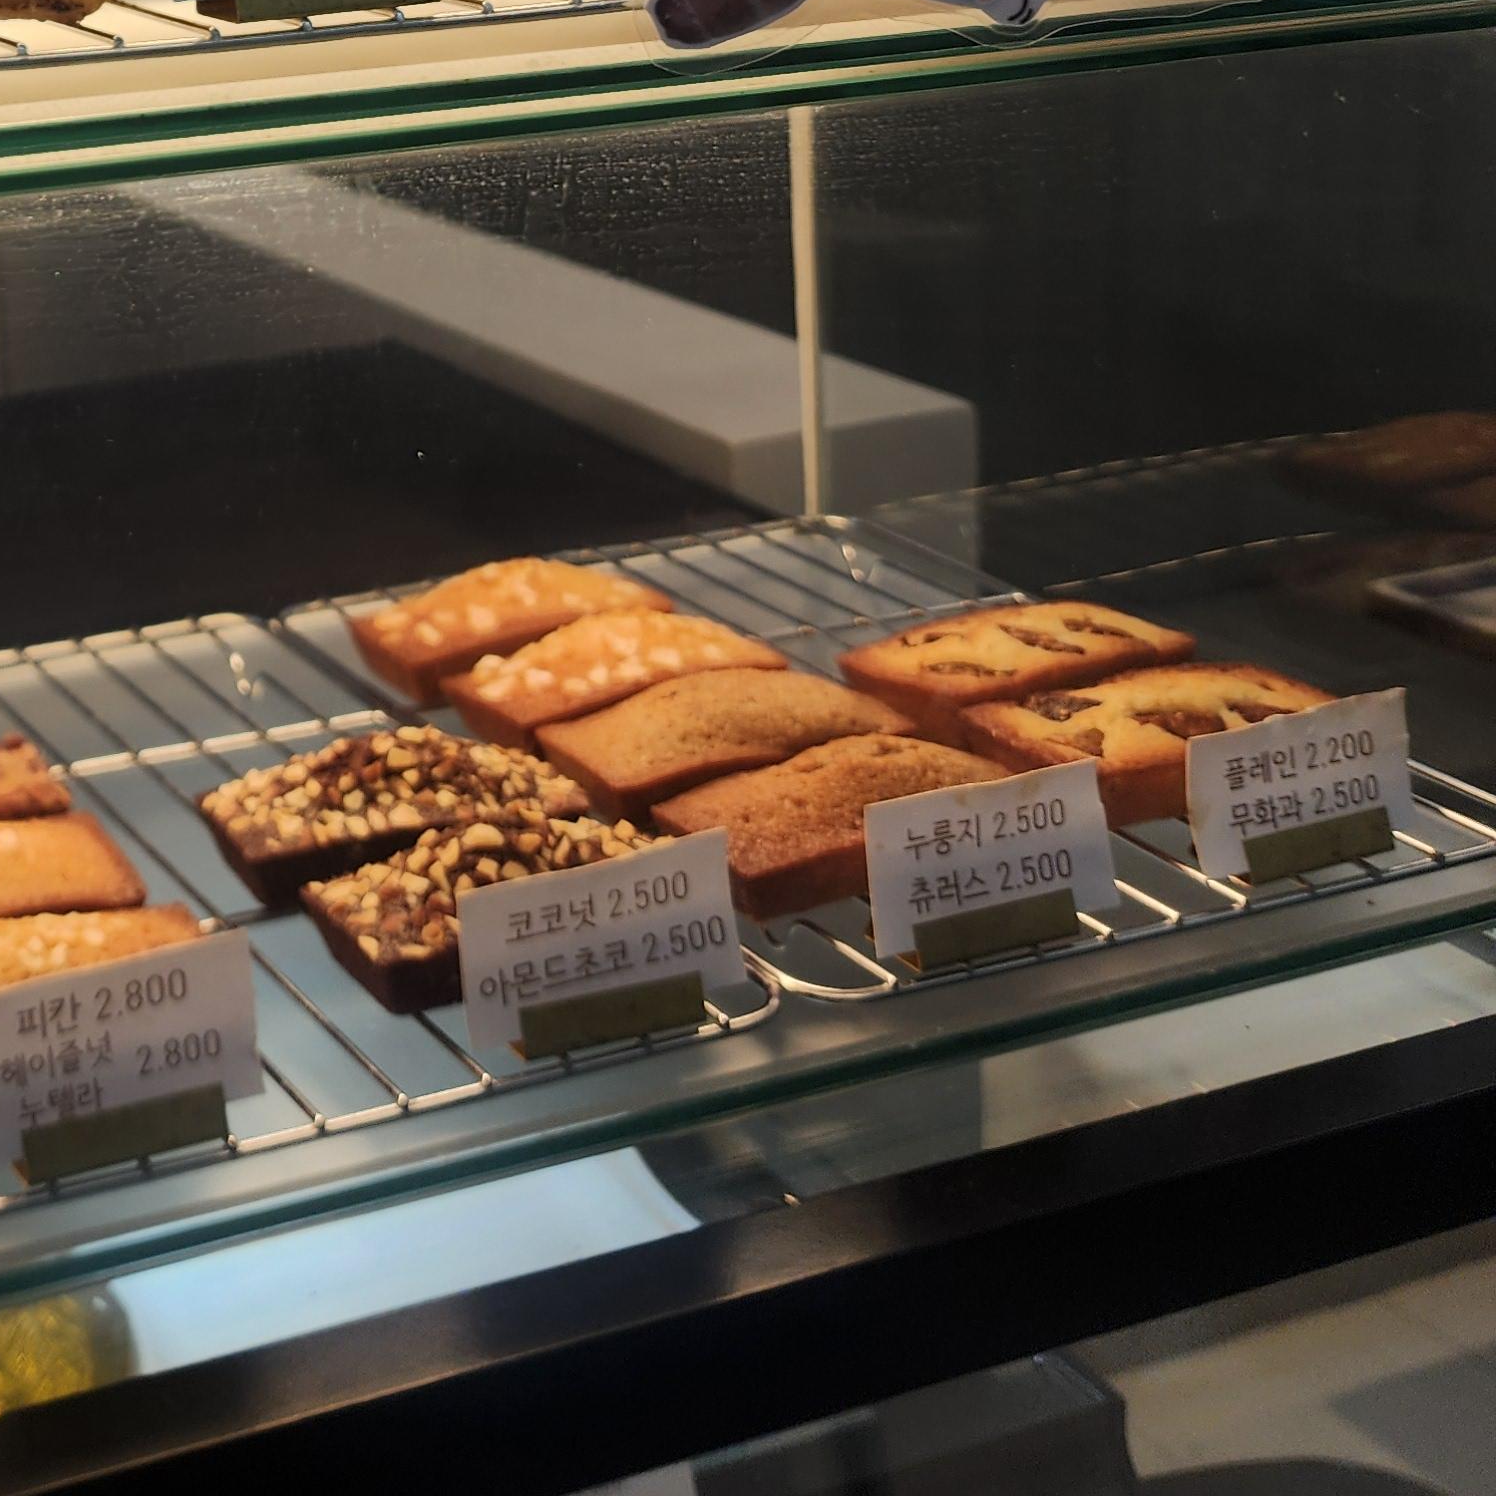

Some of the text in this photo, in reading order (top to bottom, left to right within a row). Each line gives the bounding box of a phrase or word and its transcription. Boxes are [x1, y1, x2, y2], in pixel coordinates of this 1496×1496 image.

[1222, 728, 1376, 792] 플레인 2.200
[903, 797, 1067, 862] 누룽지 2.500
[1226, 772, 1382, 838] 무화과 2.500
[505, 870, 689, 945] 코코넛 2.500
[908, 848, 1074, 916] 츄러스 2.500
[478, 914, 728, 1006] 아몬드초코 2.500
[16, 967, 188, 1039] 피칸 2.800
[136, 1027, 223, 1077] 2.800
[19, 1077, 104, 1128] 누텔라
